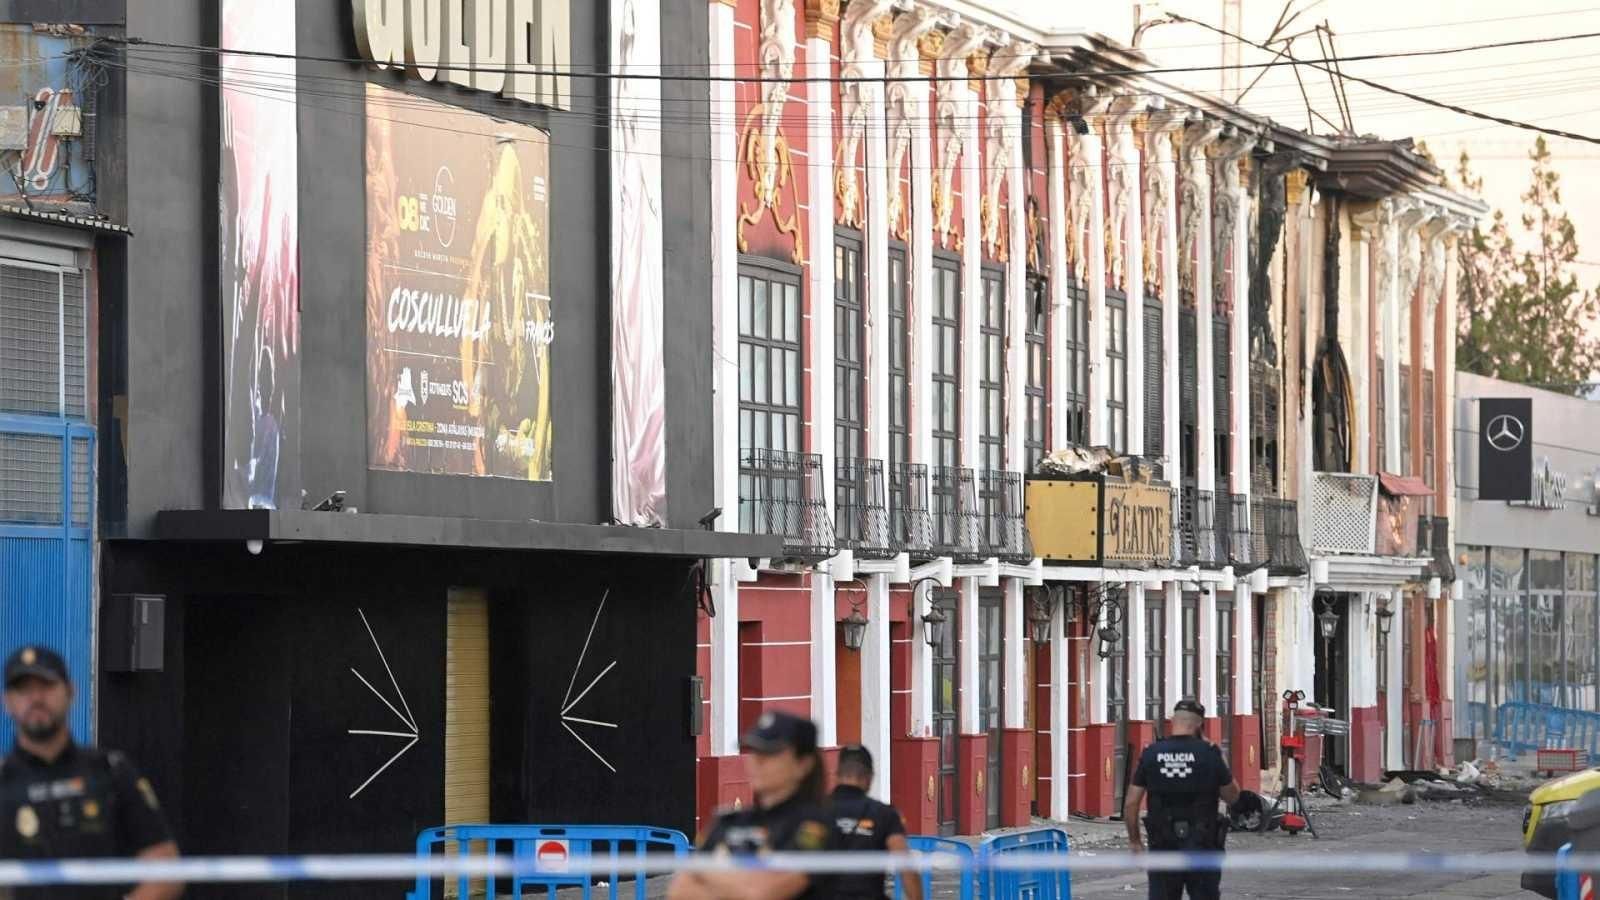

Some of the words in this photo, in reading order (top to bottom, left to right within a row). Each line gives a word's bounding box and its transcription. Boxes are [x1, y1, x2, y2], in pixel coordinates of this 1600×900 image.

[399, 195, 419, 232] 08
[432, 194, 457, 217] GOLDEN
[387, 285, 492, 343] COSCULLUELA
[1109, 493, 1165, 556] TEATRE
[1157, 753, 1195, 763] POLICIA
